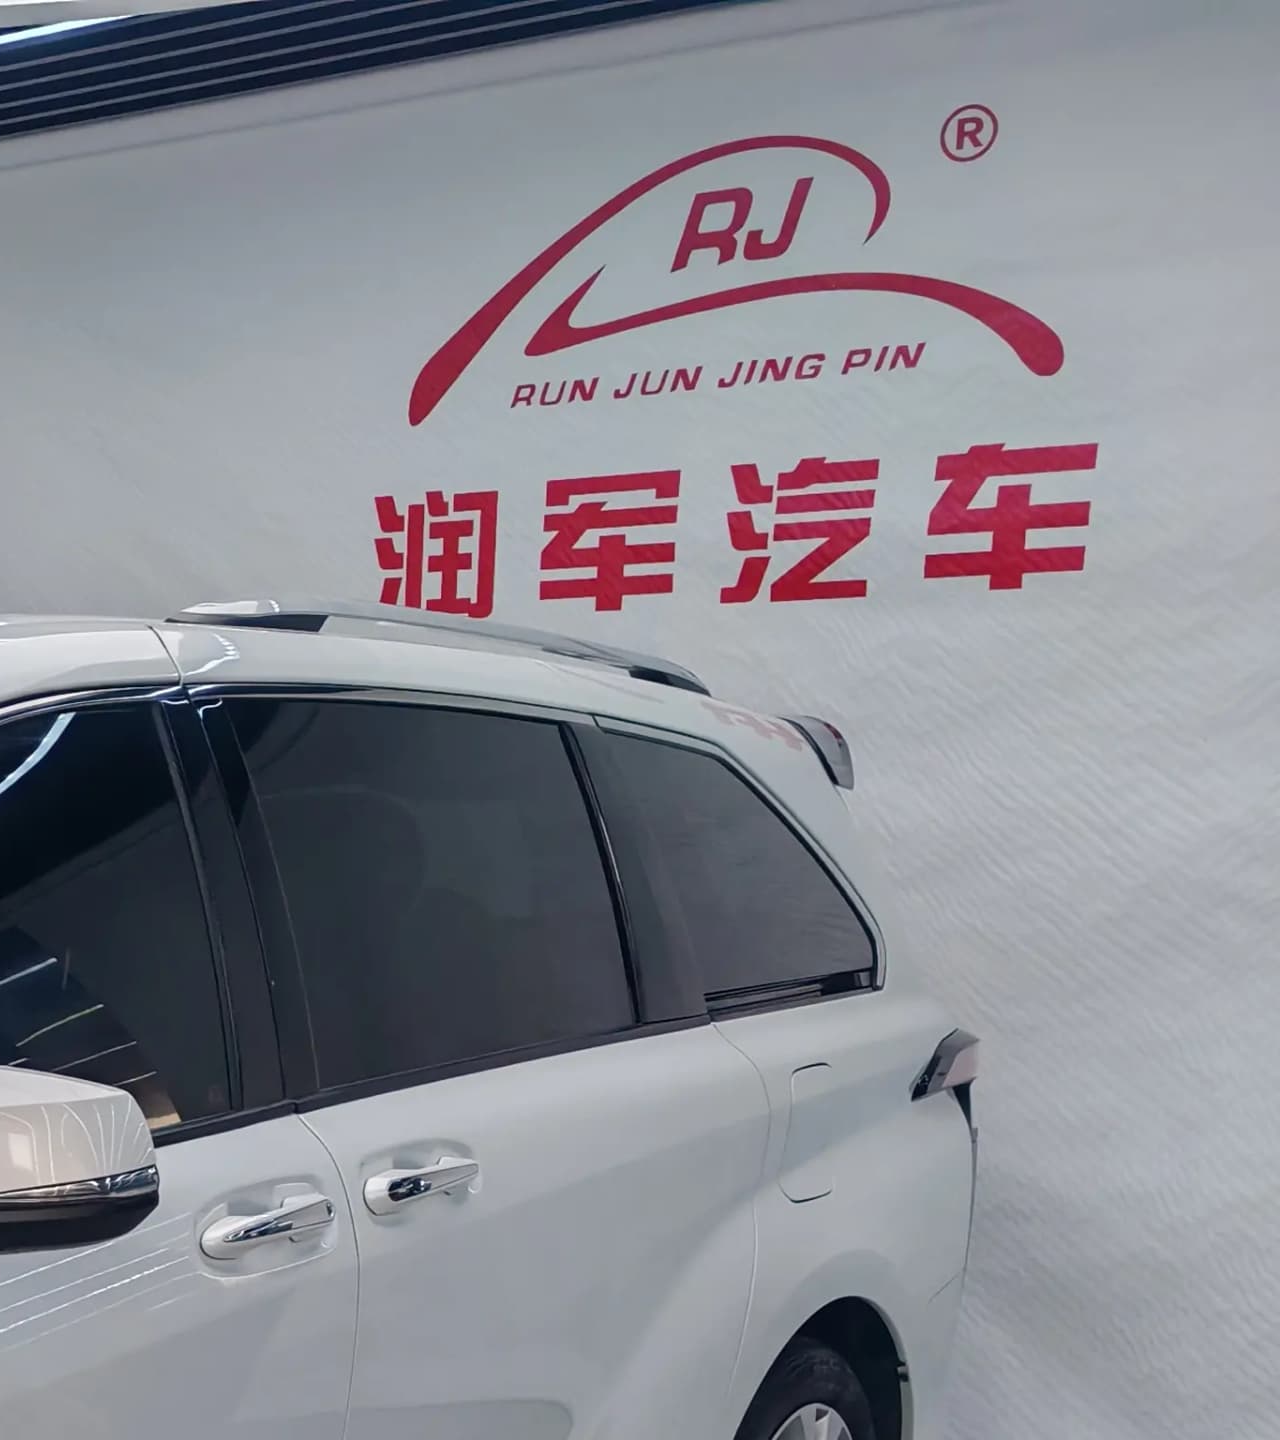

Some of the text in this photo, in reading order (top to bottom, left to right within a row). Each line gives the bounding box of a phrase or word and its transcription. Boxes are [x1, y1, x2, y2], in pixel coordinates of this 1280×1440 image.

[671, 176, 814, 273] RJ
[510, 342, 926, 409] RUN JUN JING PIN
[373, 443, 1099, 619] 润军汽车
